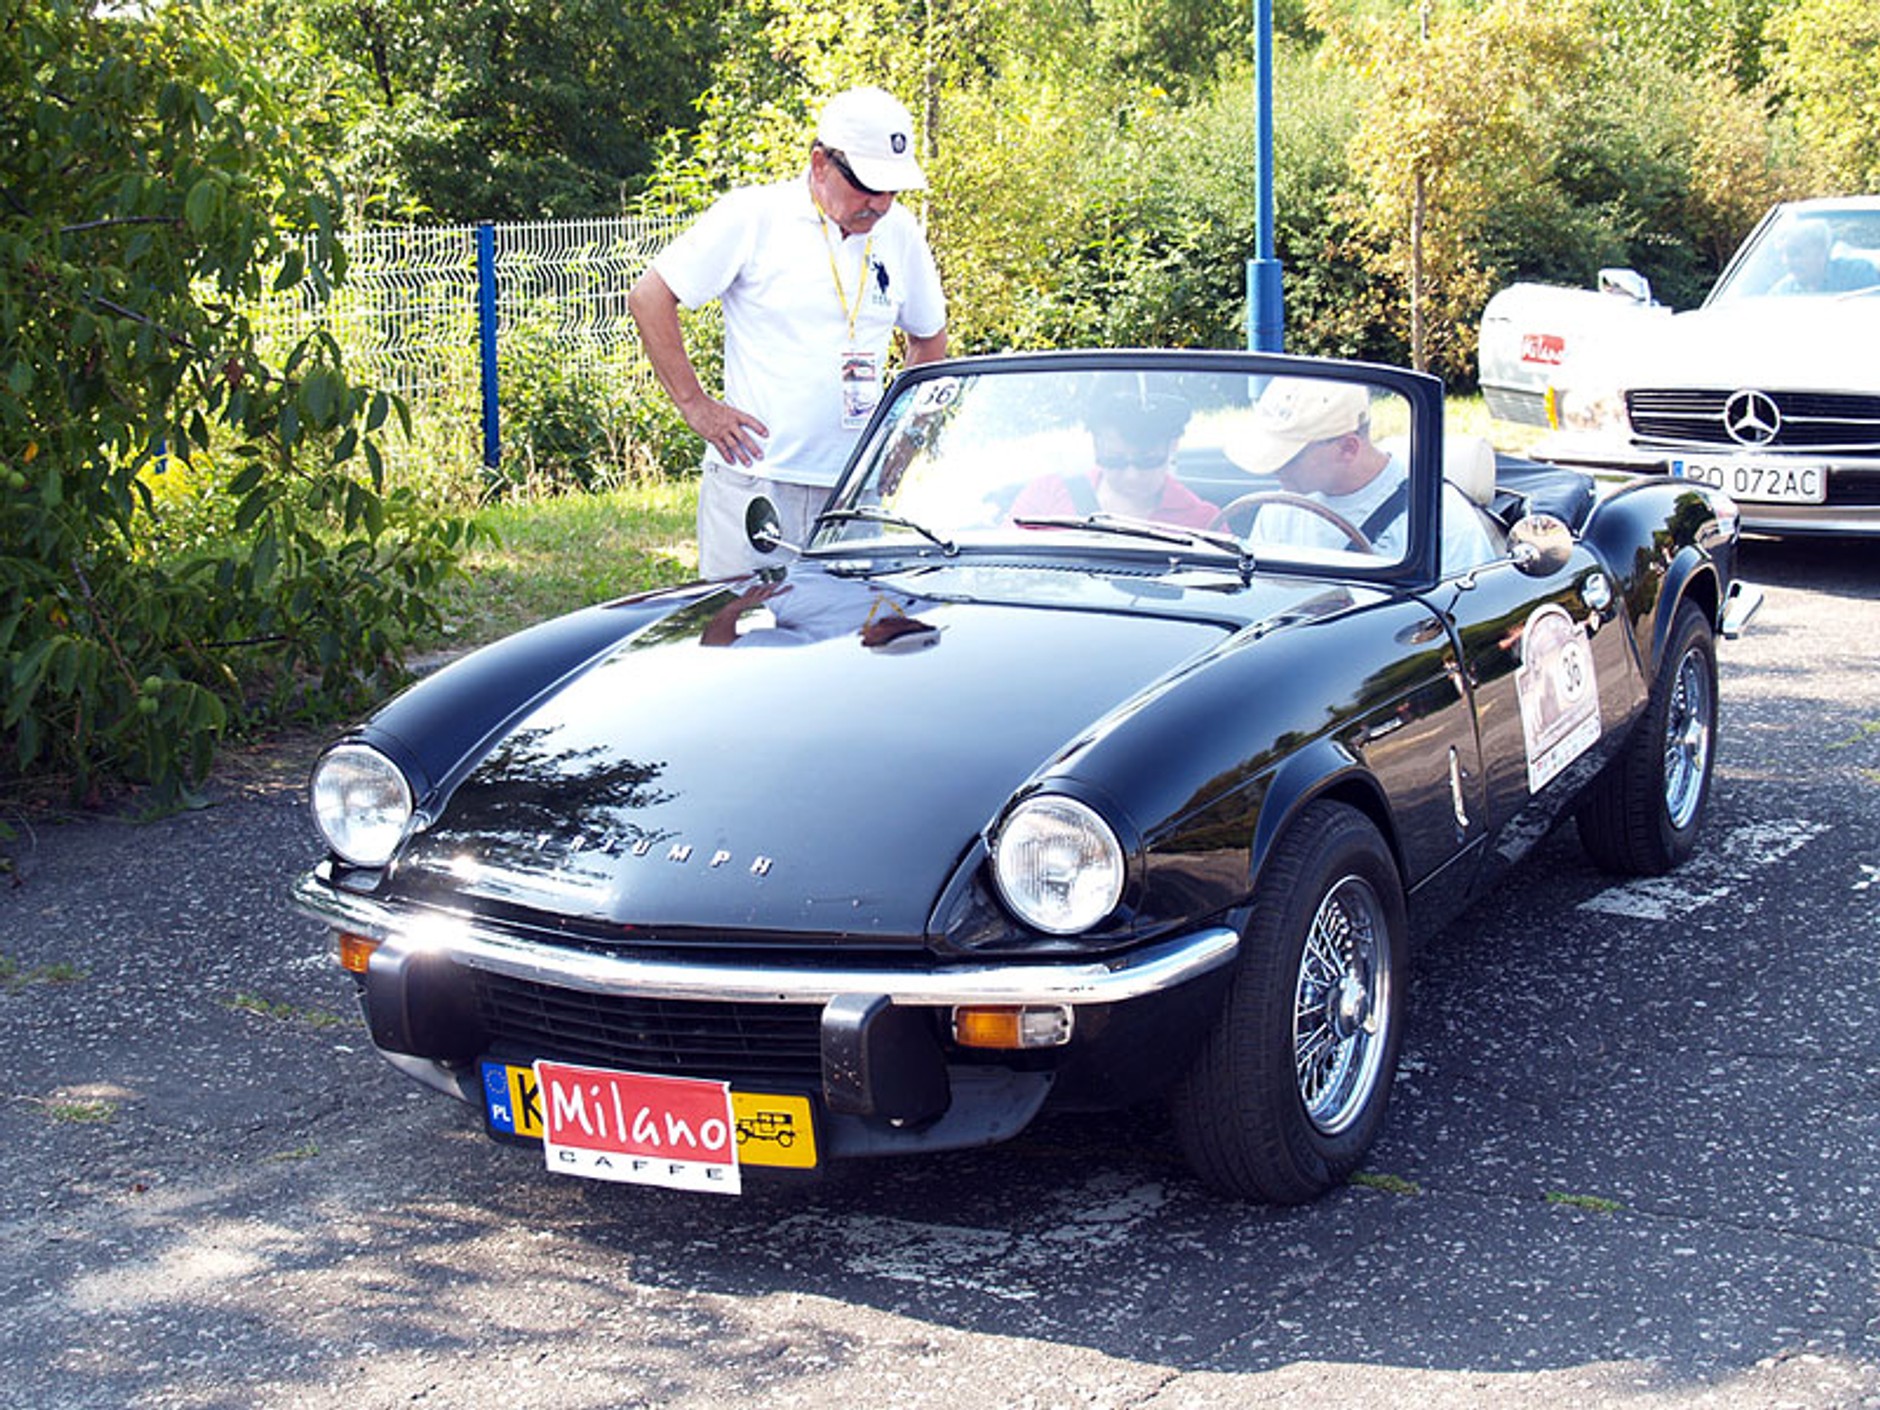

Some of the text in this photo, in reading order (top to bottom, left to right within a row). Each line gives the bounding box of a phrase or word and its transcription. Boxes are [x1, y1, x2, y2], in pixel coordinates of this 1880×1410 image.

[1734, 467, 1816, 495] 072AC
[535, 834, 774, 877] TRIUMPH
[491, 1103, 511, 1122] PL
[551, 1080, 727, 1151] Milano
[559, 1150, 725, 1181] CAFFE
